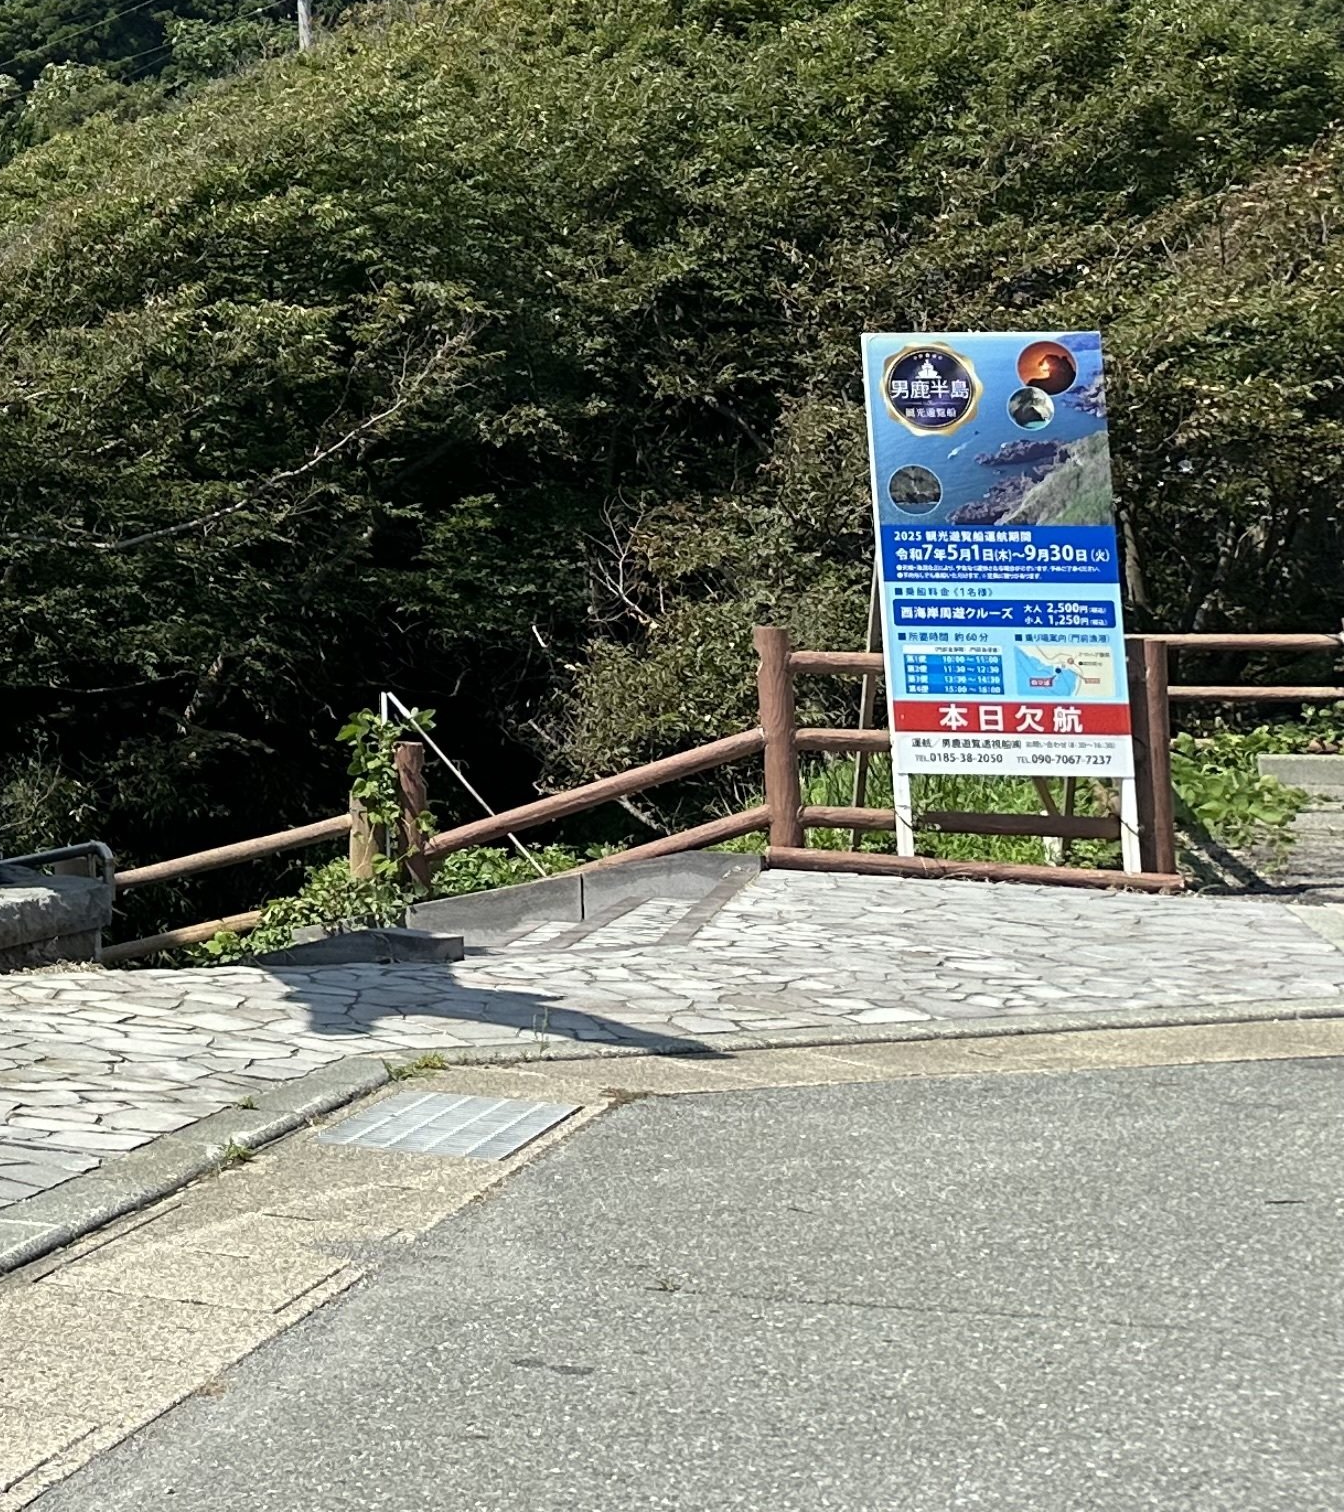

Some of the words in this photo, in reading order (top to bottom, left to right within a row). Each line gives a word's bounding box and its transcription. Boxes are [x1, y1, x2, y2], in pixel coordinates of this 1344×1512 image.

[890, 378, 971, 400] 男鹿半島
[893, 531, 923, 542] 2025
[900, 605, 1014, 620] 西海岸周遊クルーズ
[1023, 604, 1042, 614] 大人
[938, 702, 1085, 734] 本日欠航
